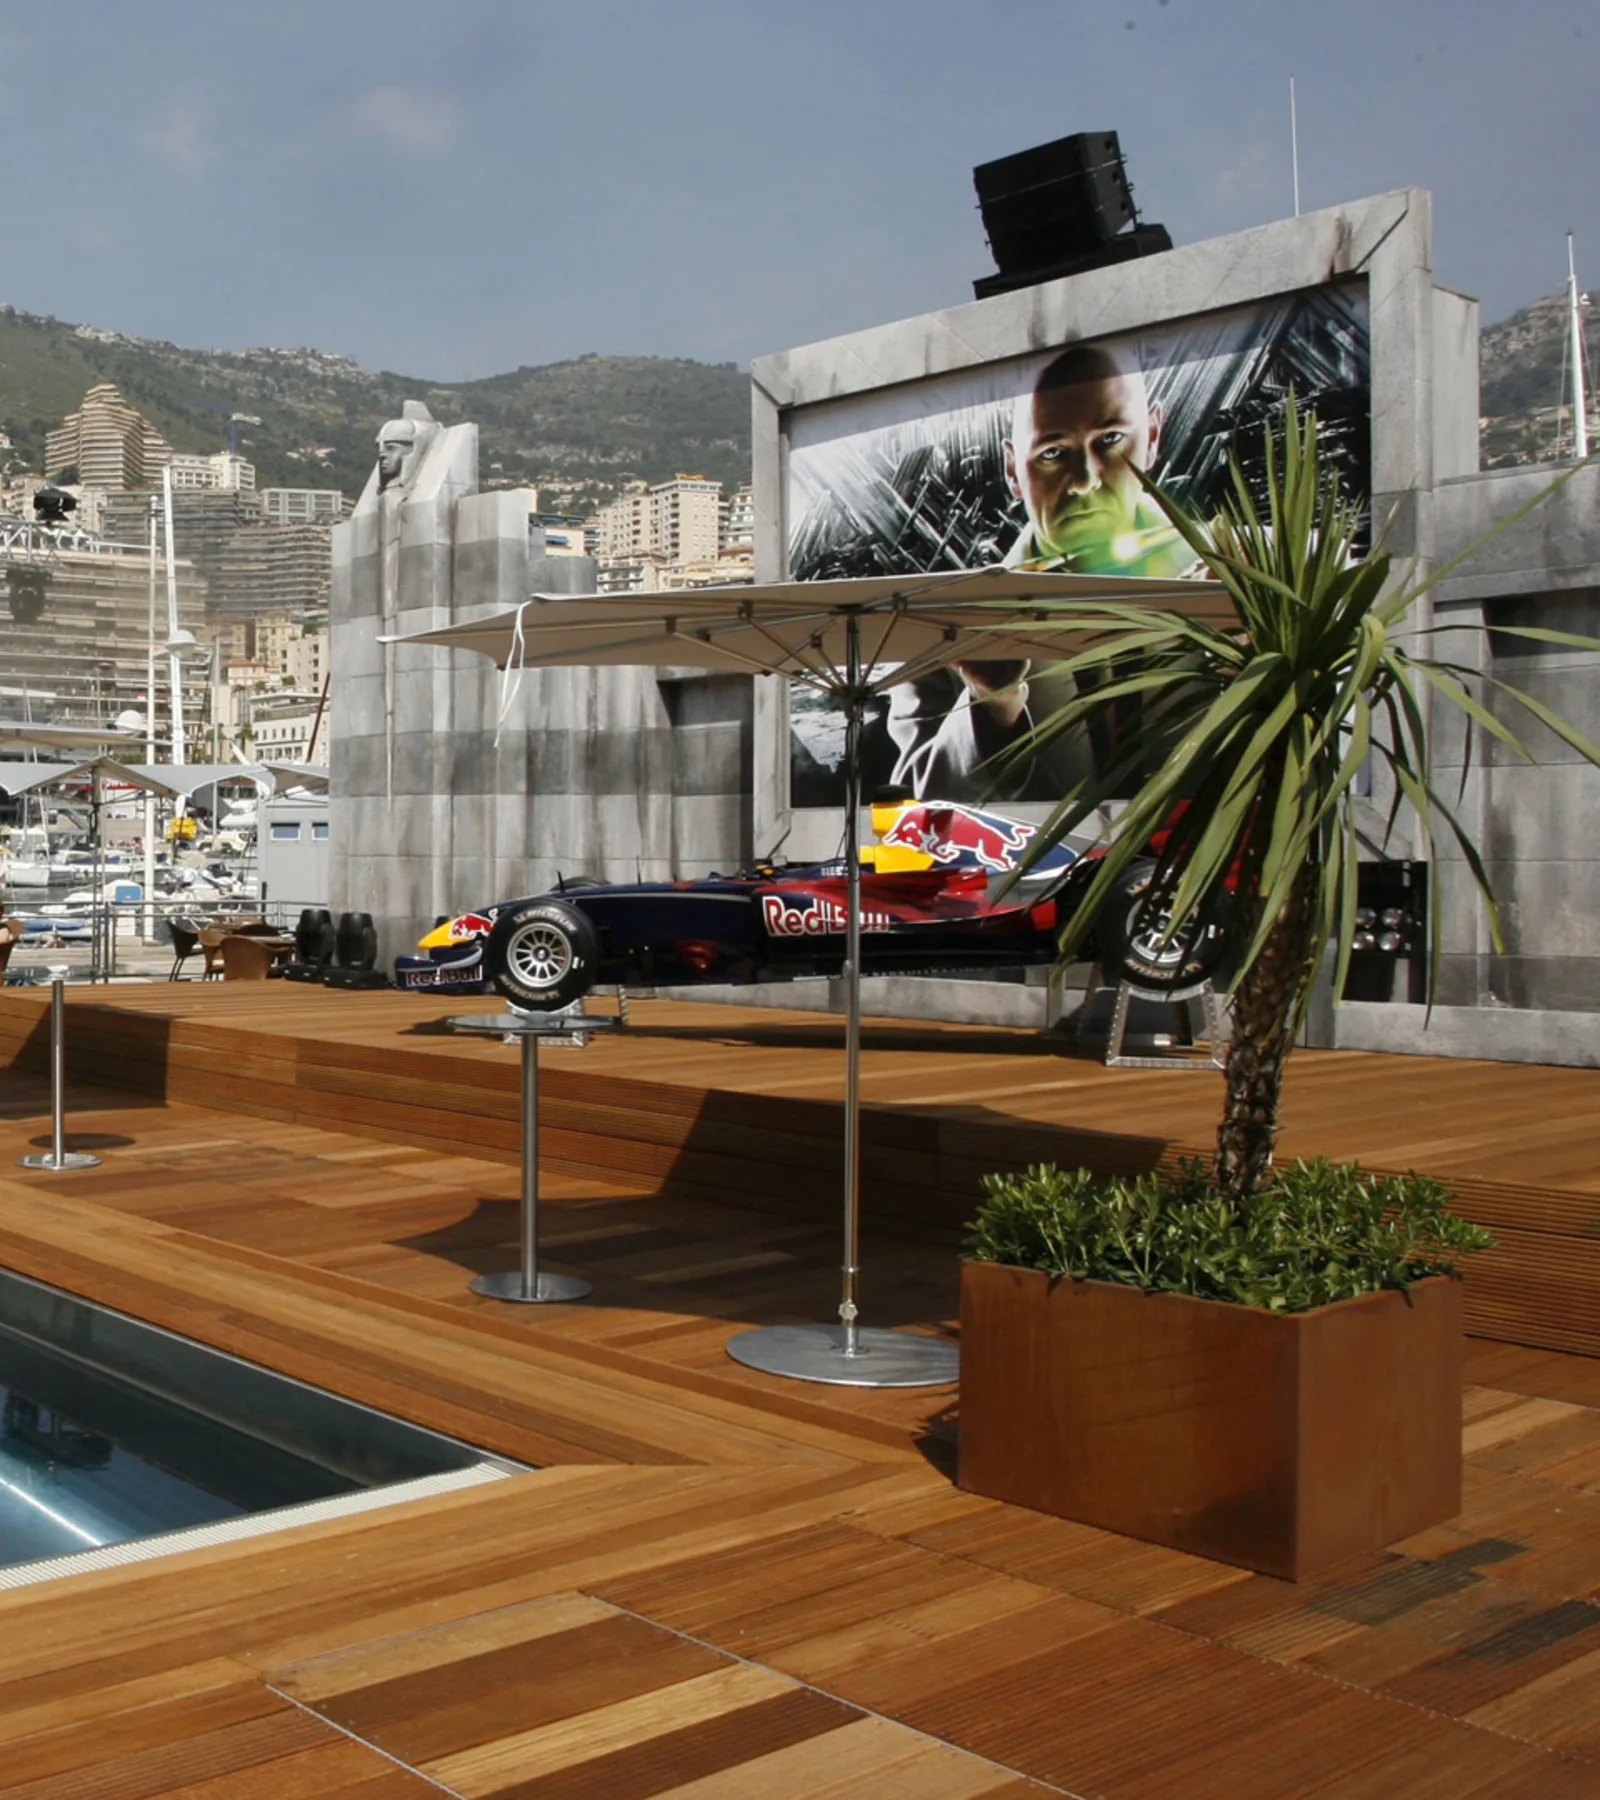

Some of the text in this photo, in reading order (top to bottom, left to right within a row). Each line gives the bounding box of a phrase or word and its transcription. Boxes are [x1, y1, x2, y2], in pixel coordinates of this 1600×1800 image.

[762, 895, 825, 937] Red
[406, 964, 483, 987] Red Bull
